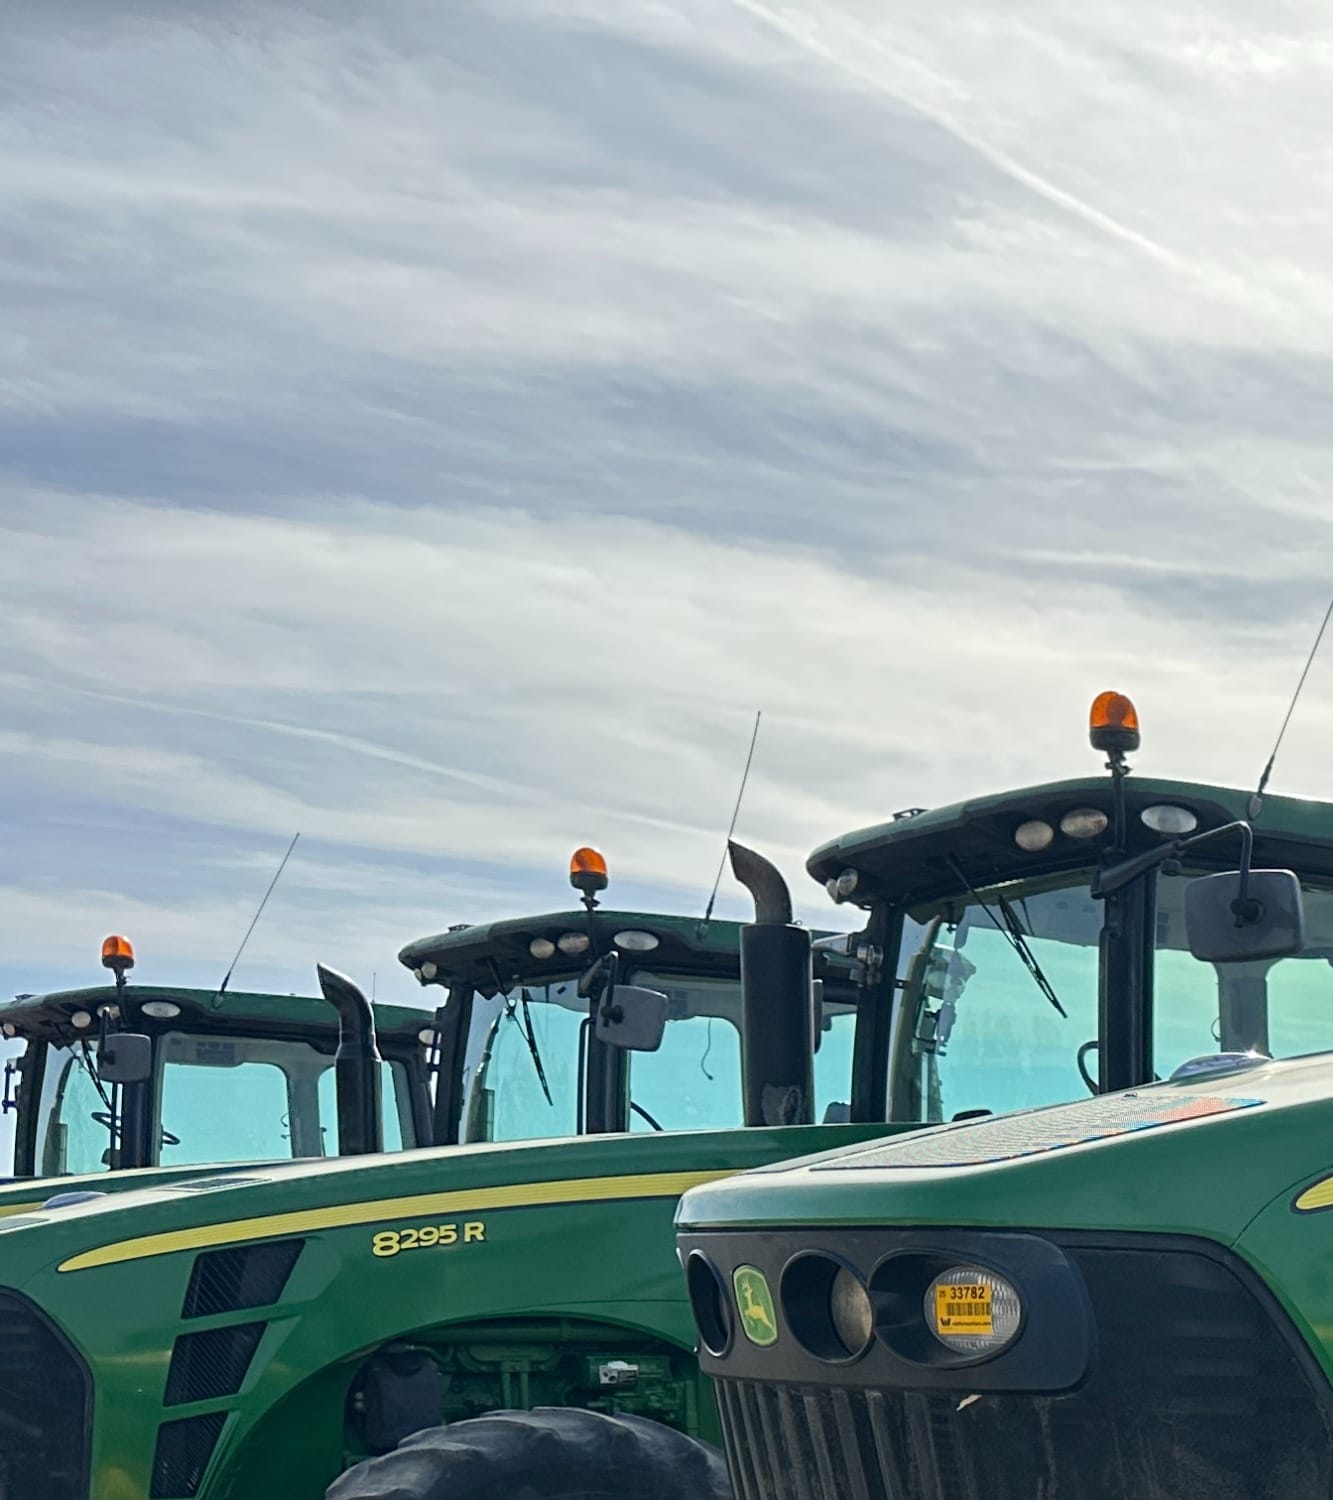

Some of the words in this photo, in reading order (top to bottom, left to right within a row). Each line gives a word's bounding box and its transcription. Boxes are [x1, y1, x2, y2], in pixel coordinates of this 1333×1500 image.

[372, 1223, 458, 1257] 8295
[463, 1221, 485, 1243] R
[950, 1286, 985, 1300] 33782
